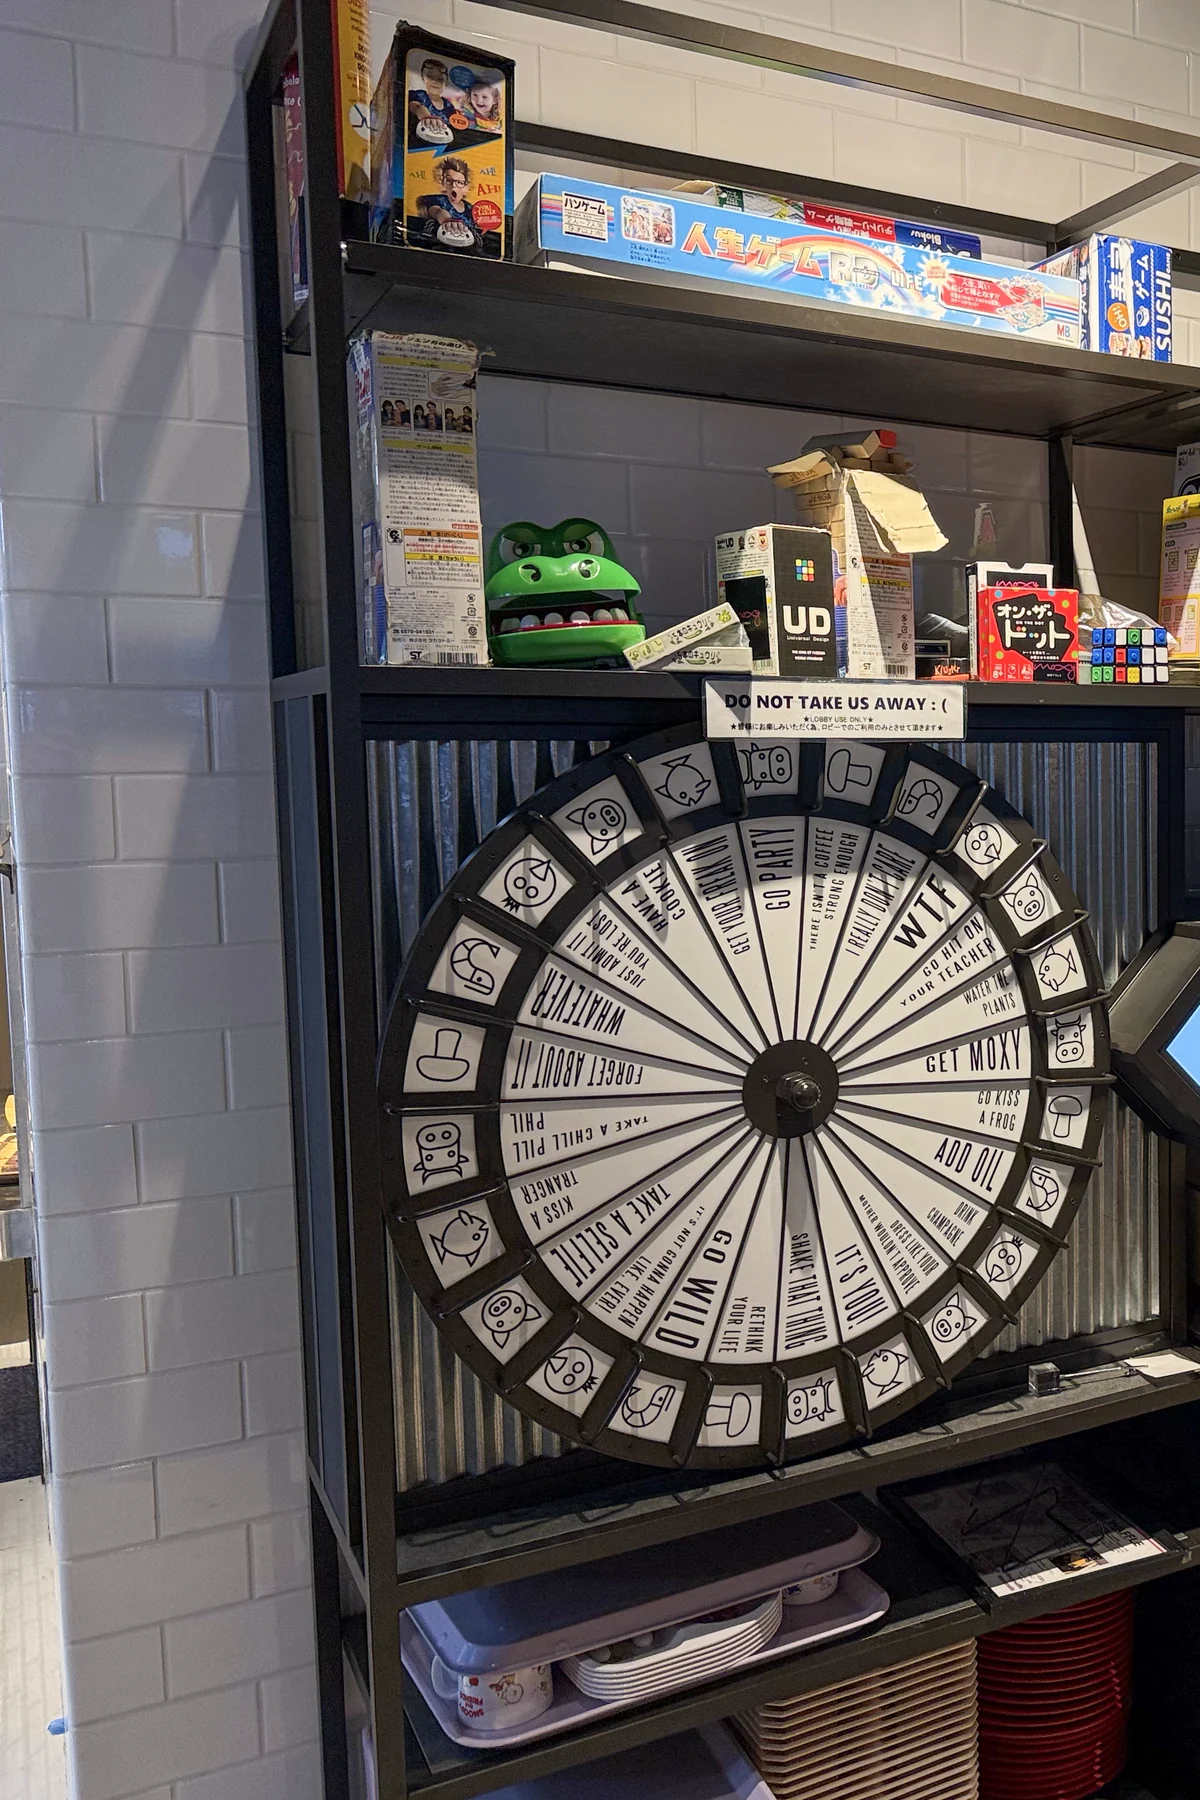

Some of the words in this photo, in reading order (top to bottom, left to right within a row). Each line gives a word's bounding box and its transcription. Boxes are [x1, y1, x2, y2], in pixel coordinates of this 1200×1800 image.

[477, 183, 501, 196] AH!
[681, 221, 823, 279] 人生ゲーム
[911, 230, 942, 246] Blokus
[891, 270, 924, 291] LIFE
[1135, 254, 1150, 301] ゲーム
[1155, 271, 1172, 350] SUSHI
[1056, 323, 1071, 337] MB
[808, 492, 832, 504] JENGA
[782, 605, 831, 635] UD
[1004, 618, 1071, 649] ドット
[725, 694, 750, 709] DO
[757, 695, 793, 709] NOT
[798, 696, 842, 709] TAKE
[848, 697, 869, 710] US
[875, 698, 926, 710] AWAY
[681, 835, 727, 862] ON
[749, 829, 795, 884] PARTY
[816, 827, 834, 868] COFFEE
[834, 832, 859, 876] ENOUGH
[872, 829, 916, 882] CARE
[621, 880, 638, 896] A
[643, 862, 686, 921] COOKIE
[691, 856, 737, 902] FREAK
[819, 870, 827, 880] A
[765, 889, 791, 911] GO
[813, 883, 824, 916] ISN'T
[825, 877, 844, 919] STRONG
[861, 873, 899, 914] DON'T
[586, 909, 615, 938] LOST
[632, 895, 669, 932] HAVE
[711, 899, 745, 932] YOUR
[894, 873, 957, 950] WTF
[567, 932, 585, 950] IT
[726, 931, 751, 955] GET
[809, 919, 820, 950] THERE
[847, 908, 881, 950] REALLY
[585, 942, 622, 972] ADMIT
[613, 932, 650, 970] YOU'RE
[845, 948, 860, 957] I
[922, 958, 940, 978] GO
[941, 936, 961, 959] HIT
[964, 916, 984, 940] ON
[617, 966, 646, 988] JUST
[900, 982, 934, 1006] YOUR
[938, 937, 996, 983] TEACHER
[963, 977, 992, 1005] WATER
[992, 969, 1010, 988] THE
[530, 968, 626, 1036] WHATEVER
[983, 994, 1017, 1017] PLANTS
[511, 1039, 533, 1089] IT
[533, 1045, 584, 1088] ABOUT
[926, 1047, 960, 1073] GET
[970, 1028, 1021, 1071] MOXY
[588, 1056, 644, 1086] FORGET
[978, 1091, 993, 1105] GO
[995, 1089, 1021, 1106] KISS
[511, 1112, 544, 1132] PHIL
[600, 1125, 608, 1136] A
[615, 1116, 649, 1134] TAKE
[979, 1111, 986, 1125] A
[989, 1112, 1016, 1131] FROG
[513, 1138, 546, 1162] PILL
[553, 1129, 593, 1152] CHILL
[934, 1137, 973, 1173] ADD
[971, 1148, 1005, 1192] OIL
[521, 1171, 579, 1204] TRANGER
[630, 1183, 671, 1224] TAKE
[531, 1211, 541, 1230] A
[542, 1195, 574, 1223] KISS
[610, 1210, 632, 1236] A
[688, 1206, 705, 1226] IT'S
[954, 1201, 979, 1226] DRINK
[674, 1228, 691, 1249] NOT
[926, 1206, 965, 1248] CHAMPAGNE
[550, 1221, 619, 1288] SELFIE
[703, 1229, 732, 1264] GO
[791, 1232, 814, 1275] SHAKE
[859, 1194, 878, 1223] MOTHER
[874, 1222, 902, 1264] WOULDN'T
[894, 1258, 921, 1296] APPROVE
[889, 1219, 908, 1240] DRESS
[906, 1239, 923, 1259] LIKE
[920, 1255, 939, 1277] YOUR
[623, 1256, 652, 1289] LIKE,
[649, 1247, 677, 1286] GONNA
[834, 1244, 866, 1284] IT'S
[597, 1283, 627, 1314] EVER!
[618, 1282, 655, 1329] HAPPEN
[789, 1272, 819, 1307] THAT
[846, 1272, 889, 1331] YOU!
[656, 1276, 718, 1349] WILD
[724, 1296, 748, 1326] YOUR
[785, 1303, 828, 1350] THING
[718, 1324, 738, 1354] LIFE
[744, 1306, 766, 1353] RETHINK
